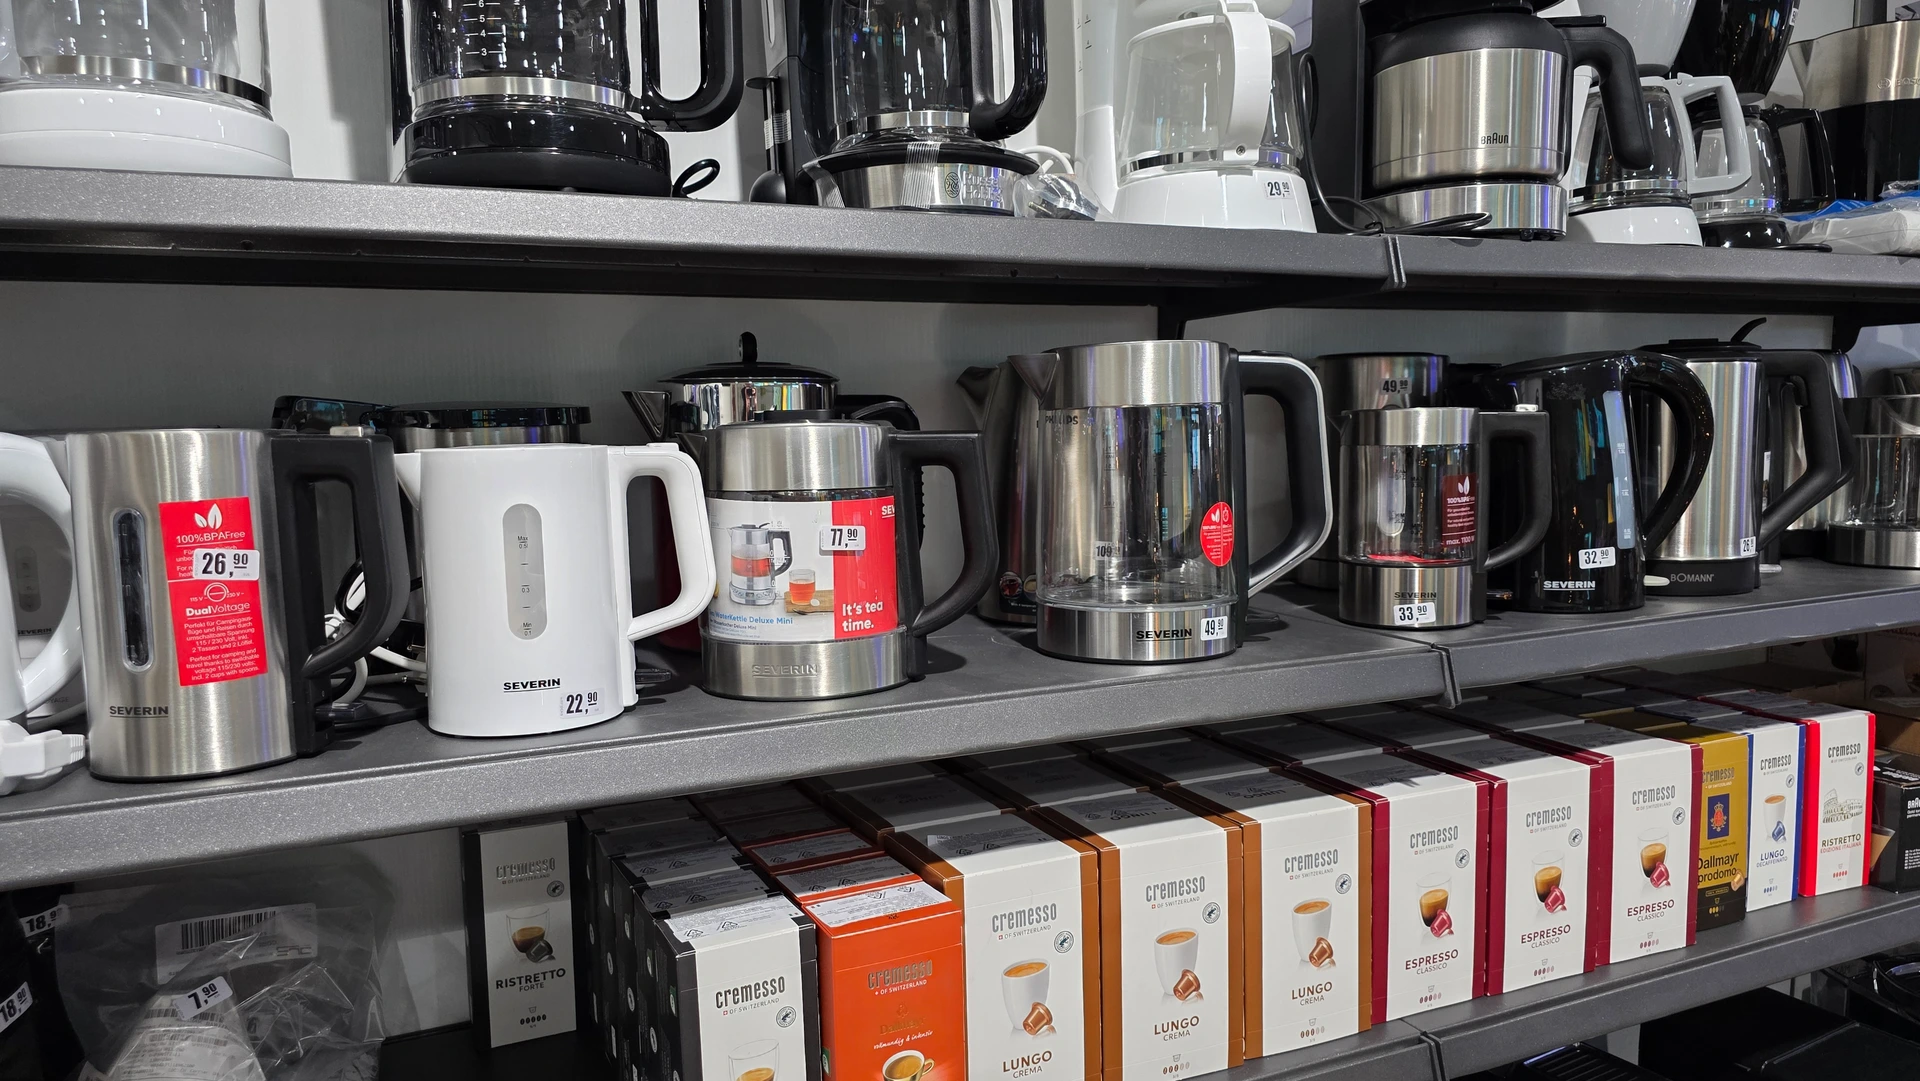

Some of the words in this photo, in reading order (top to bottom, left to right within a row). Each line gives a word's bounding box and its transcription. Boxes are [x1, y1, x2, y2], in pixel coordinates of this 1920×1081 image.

[480, 14, 486, 22] 5
[480, 30, 486, 38] 4
[481, 48, 488, 56] 3
[1481, 132, 1508, 144] BRAUN
[1268, 182, 1290, 198] 29,90
[1382, 380, 1408, 394] 49,90
[176, 531, 246, 544] 100%BPAFree
[831, 529, 858, 548] 77,90
[1584, 549, 1610, 564] 32,90
[202, 552, 248, 578] 26,90
[1670, 573, 1712, 582] BOMANN
[1544, 581, 1595, 590] SEVERIN
[1394, 592, 1436, 600] SEVERIN
[186, 602, 250, 616] DualVoltage
[866, 601, 883, 613] tea
[1399, 605, 1427, 621] 33,90
[842, 619, 874, 632] time.
[1204, 618, 1224, 636] 49,90
[1136, 628, 1192, 641] SEVERIN
[752, 664, 818, 678] SEVERIN
[503, 678, 560, 692] SEVERIN
[566, 692, 598, 714] 22,90
[110, 706, 168, 718] SEVERIN
[1828, 743, 1860, 758] cremesso
[1760, 754, 1792, 770] cremesso
[1702, 766, 1735, 783] cremesso
[1632, 784, 1676, 805] cremesso
[1526, 806, 1572, 827] cremesso
[1540, 823, 1567, 832] SWITZERLAND
[1410, 825, 1458, 848] cremesso
[1822, 833, 1861, 848] RISTRETTO
[1425, 844, 1454, 854] SWITZERLAND
[1760, 848, 1784, 861] LUNGO
[496, 857, 556, 880] cremesso
[1284, 849, 1338, 873] cremesso
[1302, 868, 1333, 878] SWITZERLAND
[1698, 868, 1737, 885] prodomo
[1146, 876, 1205, 902] cremesso
[1165, 896, 1200, 907] SWITZERLAND
[1627, 899, 1675, 917] ESPRESSO
[992, 903, 1057, 933] cremesso
[1637, 912, 1664, 922] CLASSICO
[1013, 925, 1051, 937] SWITZERLAND
[1521, 924, 1571, 944] ESPRESSO
[1531, 937, 1560, 948] CLASSICO
[1405, 948, 1459, 970] ESPRESSO
[868, 959, 933, 990] cremesso
[1416, 962, 1447, 975] CLASSICO
[496, 968, 566, 989] RISTRETTO
[889, 979, 928, 993] SWITZERLAND
[519, 982, 544, 992] FORTE
[715, 976, 785, 1009] cremesso
[1292, 981, 1332, 1000] LUNGO
[188, 982, 218, 1009] 7,90
[1300, 995, 1324, 1006] CREMA
[738, 998, 780, 1013] SWITZERLAND
[1154, 1016, 1200, 1035] LUNGO
[874, 1036, 905, 1050] vollmundig
[911, 1029, 933, 1041] intensiv
[1163, 1030, 1190, 1042] CREMA
[1003, 1050, 1052, 1072] LUNGO
[1013, 1065, 1043, 1078] CREMA
